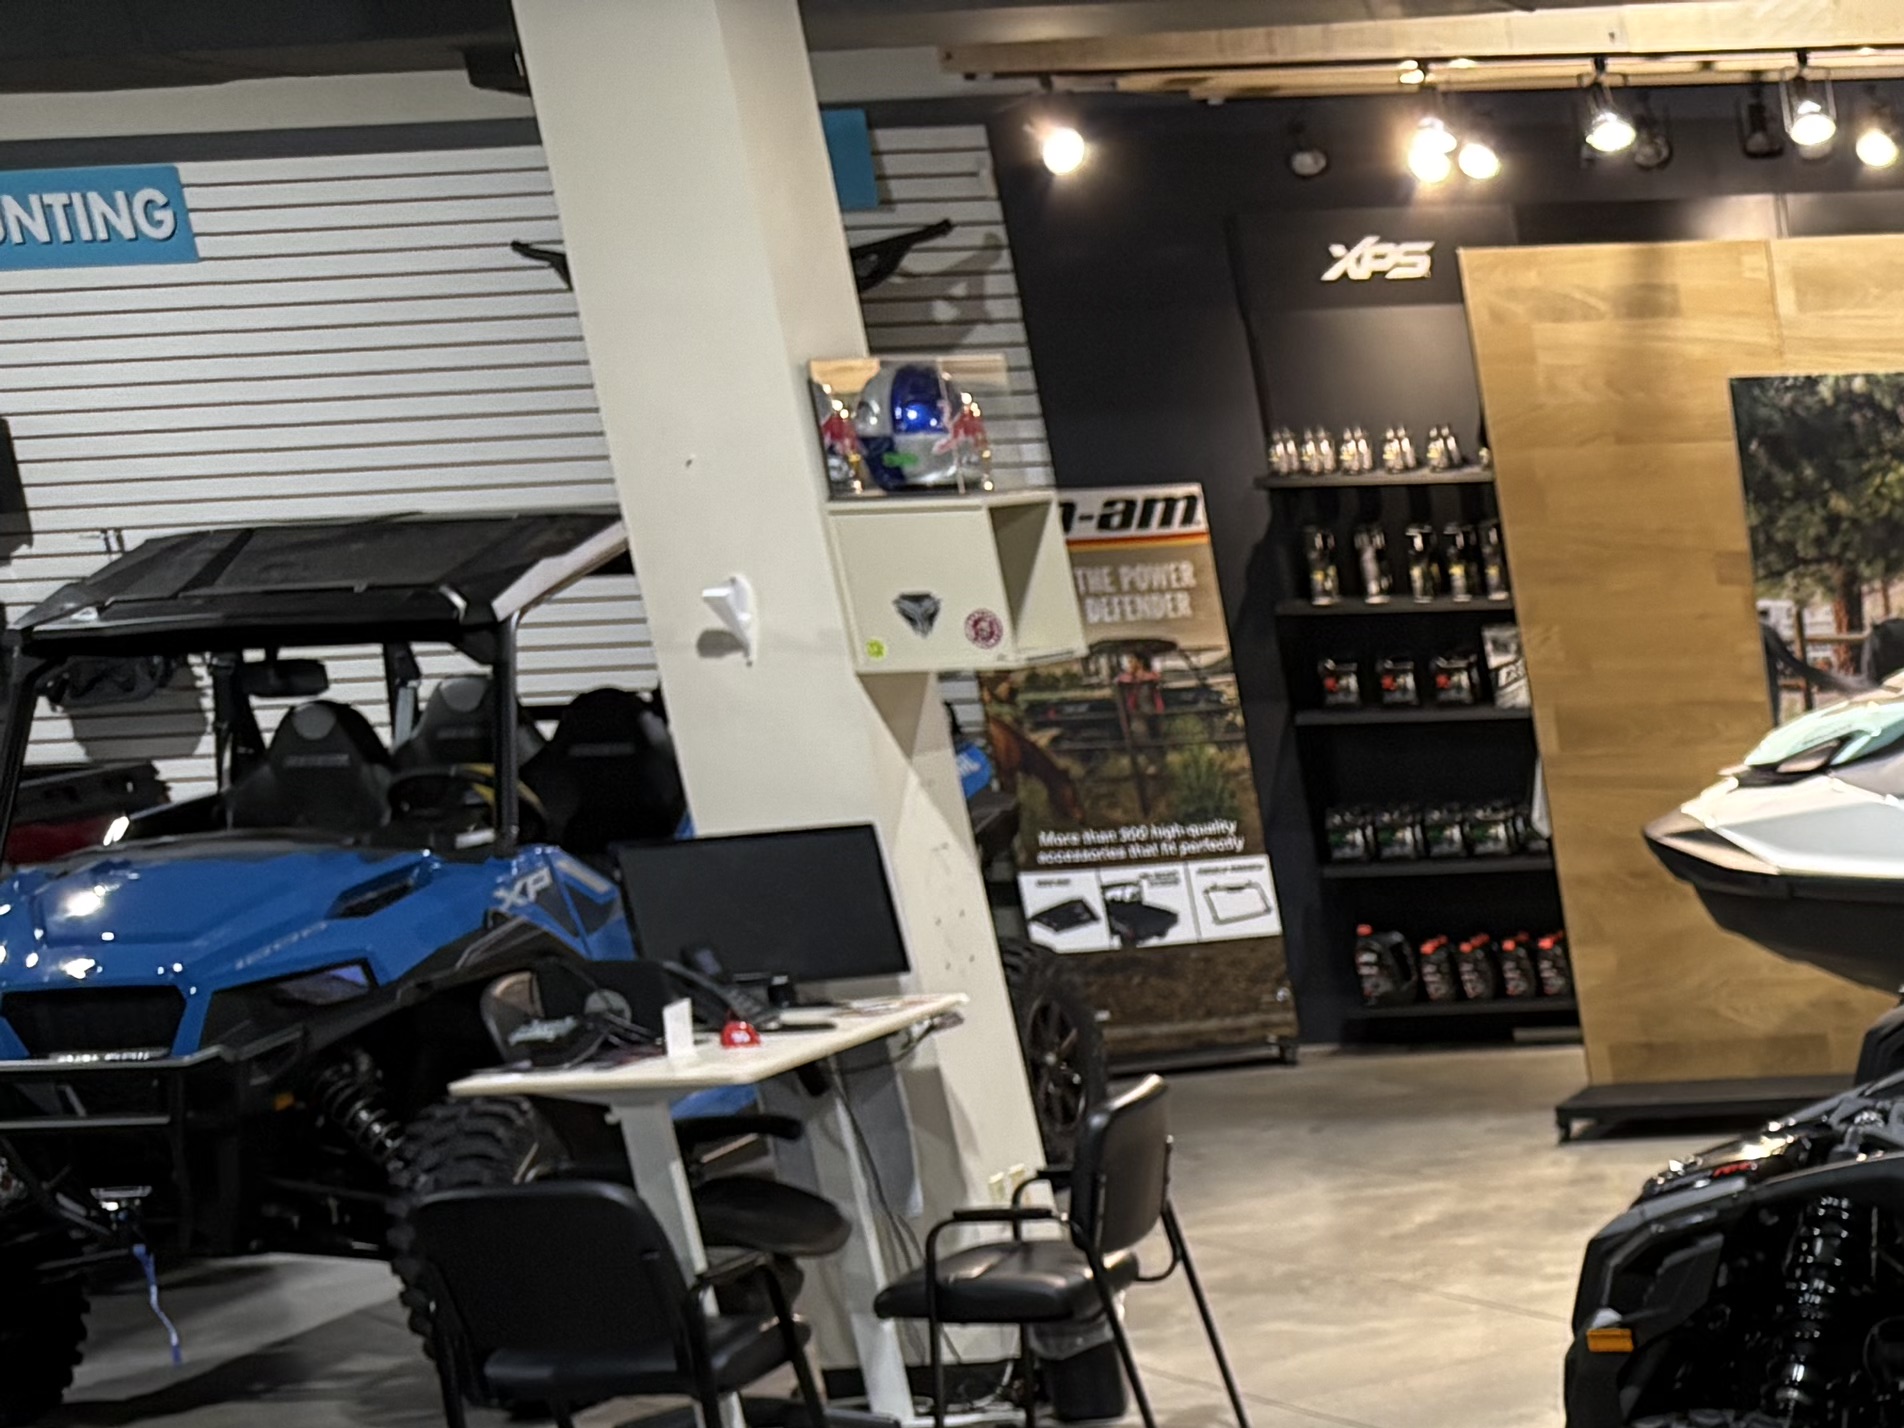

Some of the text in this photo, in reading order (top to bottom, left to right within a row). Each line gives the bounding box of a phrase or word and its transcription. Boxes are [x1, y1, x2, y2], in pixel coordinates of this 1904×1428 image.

[0, 187, 176, 246] NTING
[1320, 235, 1435, 281] XPS
[1074, 560, 1197, 596] THE POWER
[1084, 590, 1193, 625] DEFENDER
